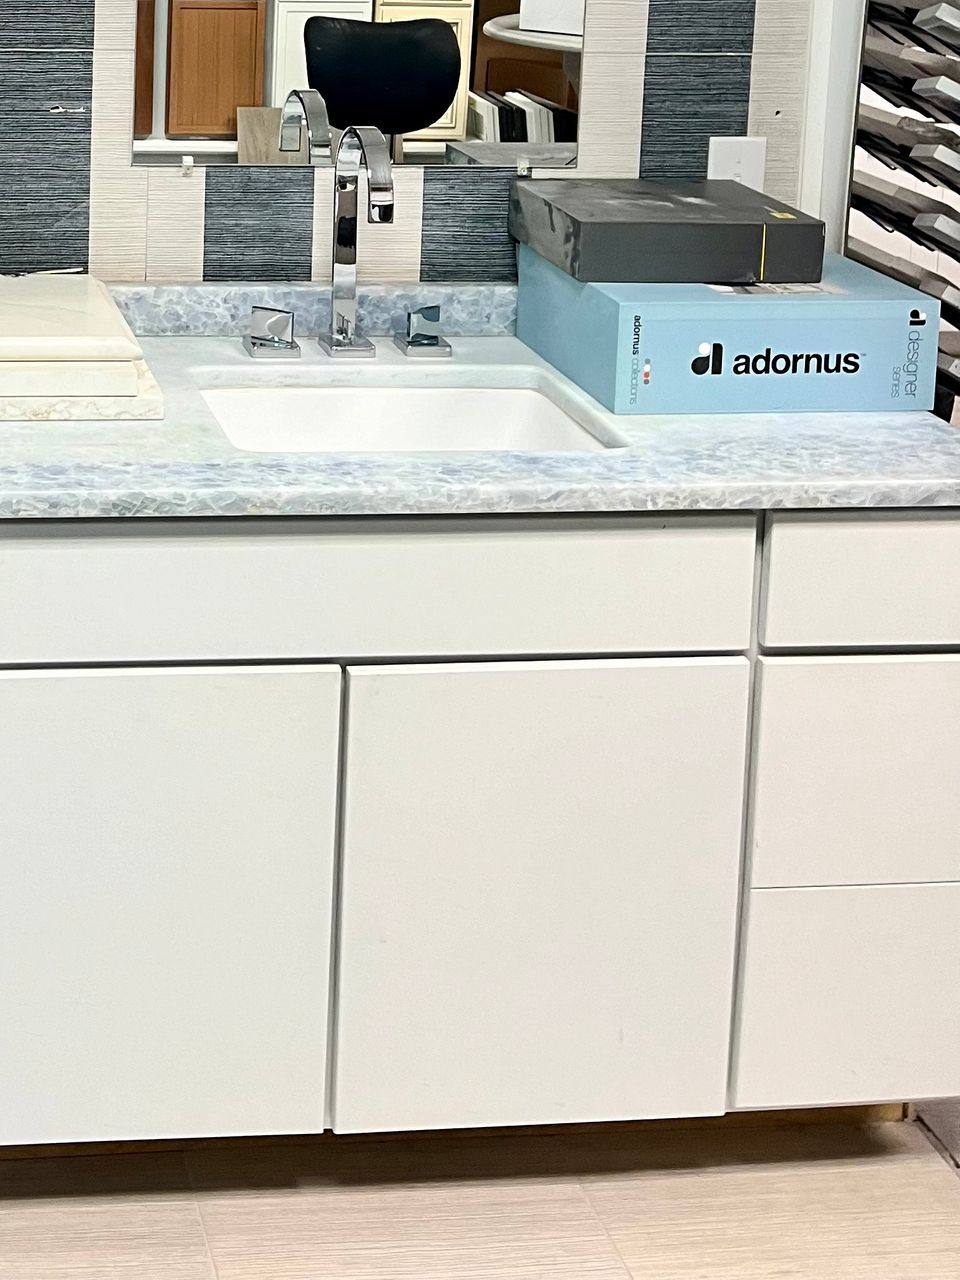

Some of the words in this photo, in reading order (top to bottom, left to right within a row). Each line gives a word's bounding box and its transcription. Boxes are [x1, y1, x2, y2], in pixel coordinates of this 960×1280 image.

[632, 315, 642, 355] adornus
[629, 358, 639, 405] collections
[733, 348, 860, 375] adornus
[902, 330, 924, 399] designer
[891, 366, 901, 399] series
